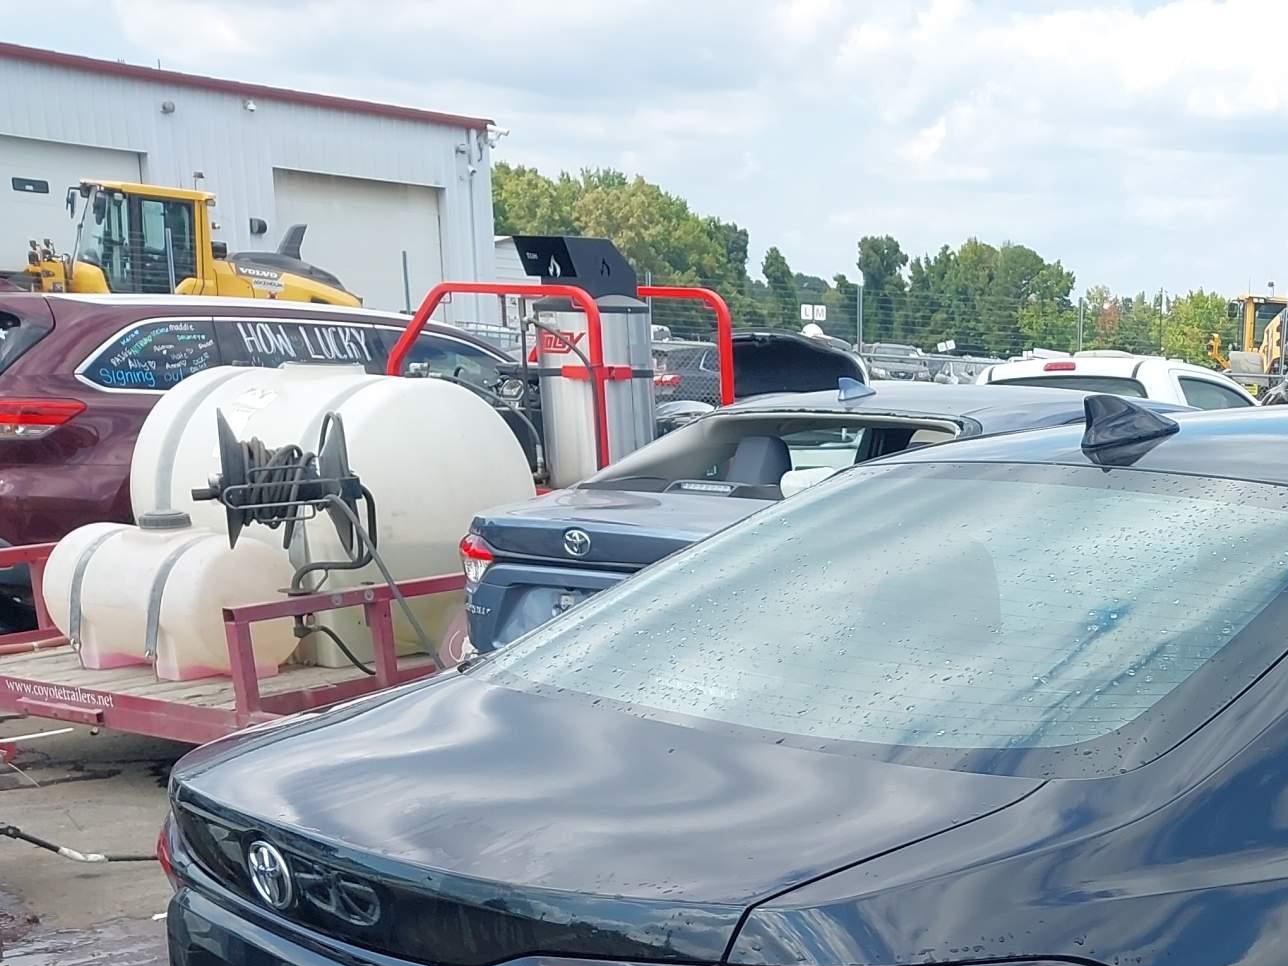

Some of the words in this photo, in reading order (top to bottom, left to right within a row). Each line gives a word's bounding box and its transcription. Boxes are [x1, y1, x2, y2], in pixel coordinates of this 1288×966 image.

[239, 267, 278, 279] VOLVO
[237, 322, 297, 358] HOW
[299, 326, 372, 361] LUCKY
[99, 368, 156, 387] Signing
[5, 679, 114, 708] www.coyotetrailers.net
